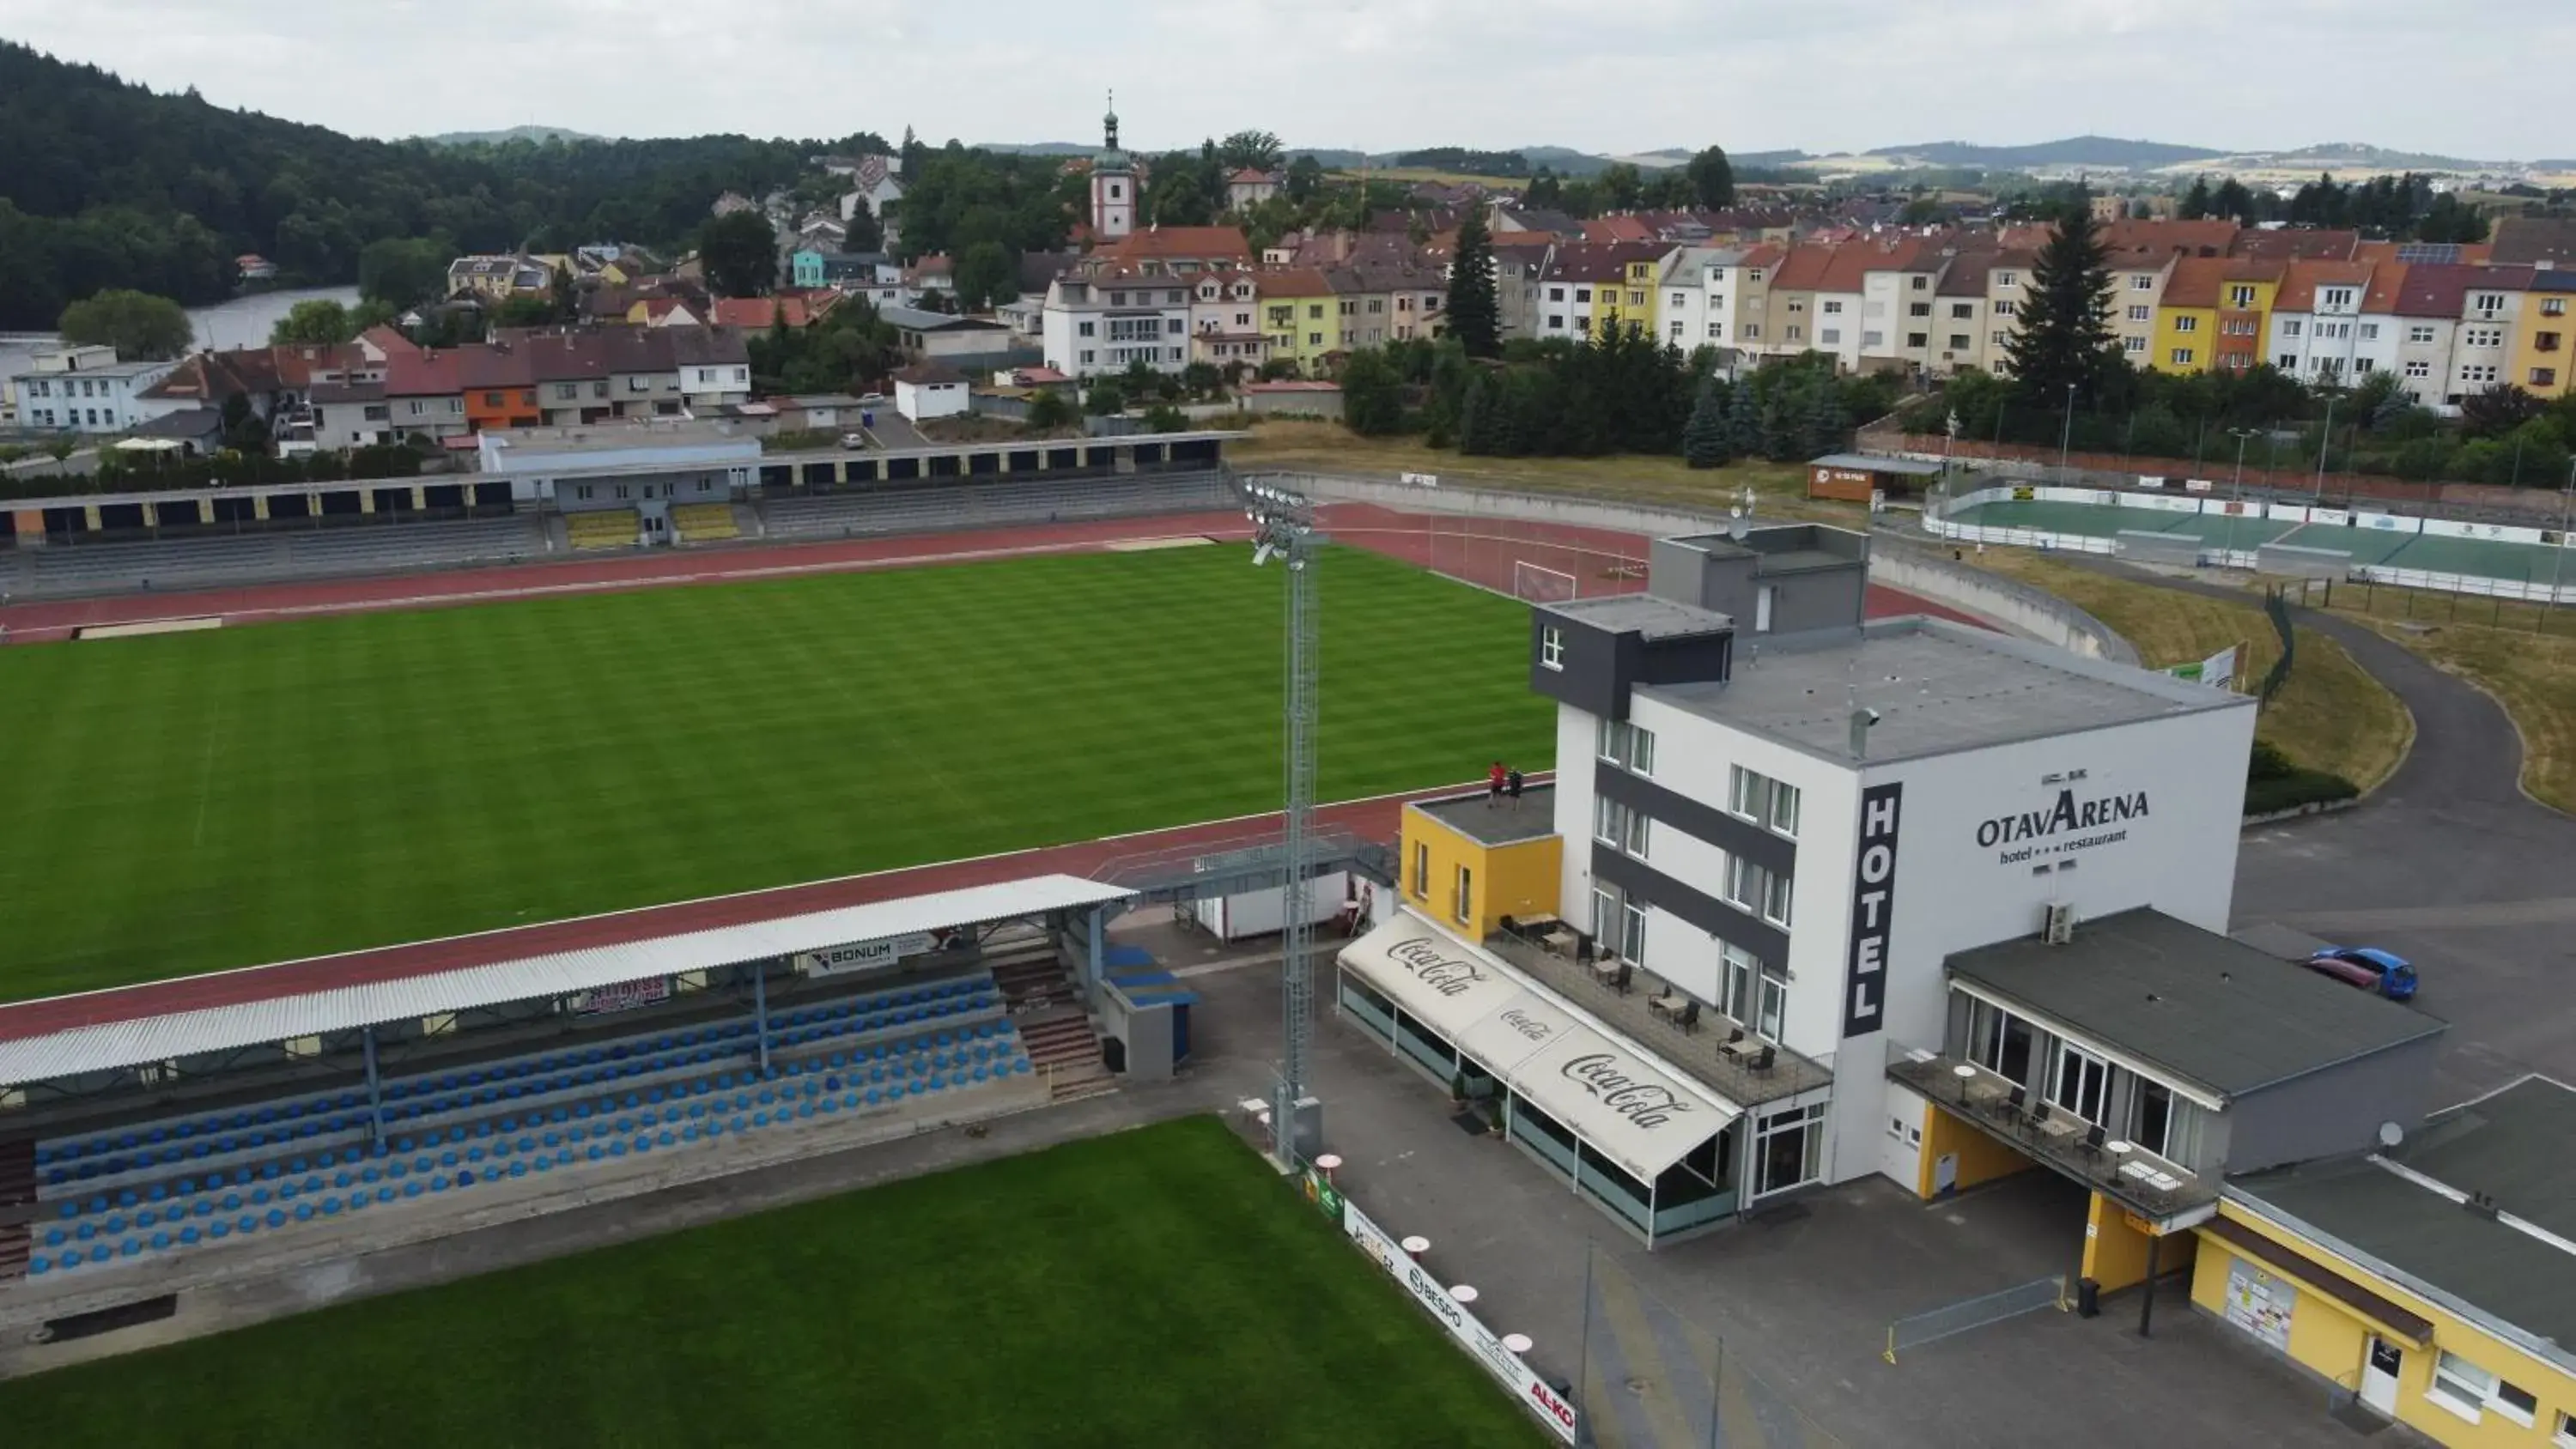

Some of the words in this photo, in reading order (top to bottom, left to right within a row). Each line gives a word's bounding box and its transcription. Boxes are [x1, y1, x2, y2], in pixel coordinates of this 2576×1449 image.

[1977, 789, 2149, 848] OTAVARENA
[2000, 846, 2032, 865] hotel
[2063, 829, 2127, 852] restaurant
[1854, 797, 1895, 1019] HOTEL
[831, 944, 891, 963] BONUM
